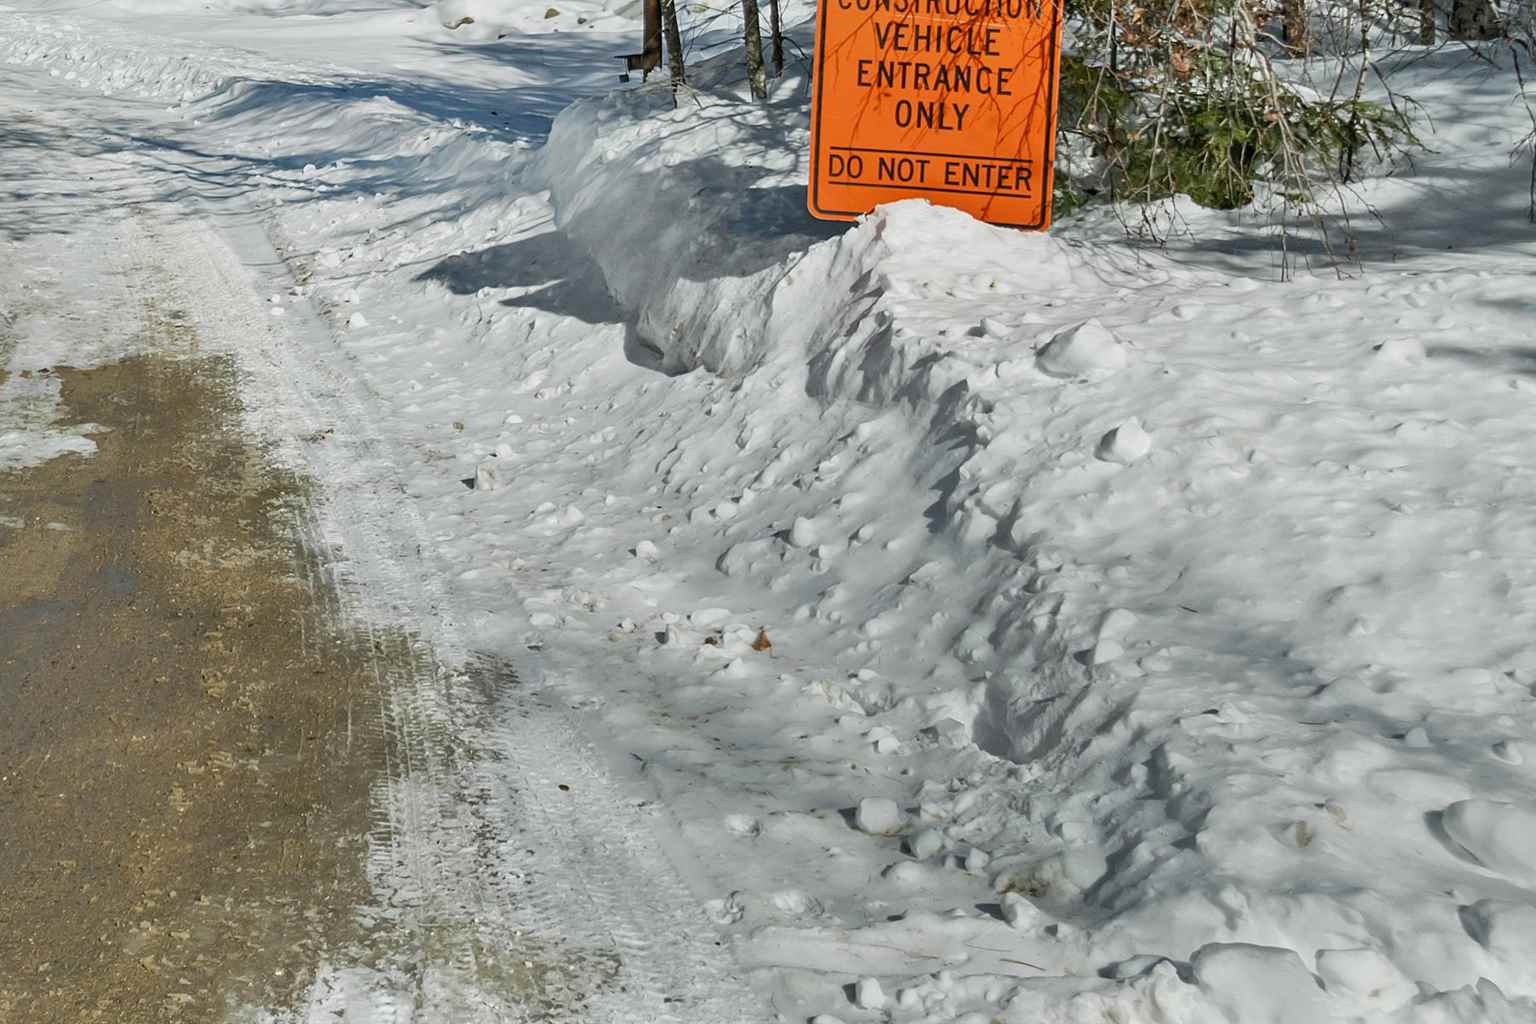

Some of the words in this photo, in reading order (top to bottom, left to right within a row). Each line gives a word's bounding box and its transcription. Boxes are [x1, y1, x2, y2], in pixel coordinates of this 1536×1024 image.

[874, 22, 1001, 57] VEHICLE
[857, 60, 1012, 96] ENTRANCE
[895, 99, 970, 131] ONLY
[829, 154, 864, 179] DO
[878, 157, 930, 184] NOT
[944, 161, 1033, 192] ENTER
